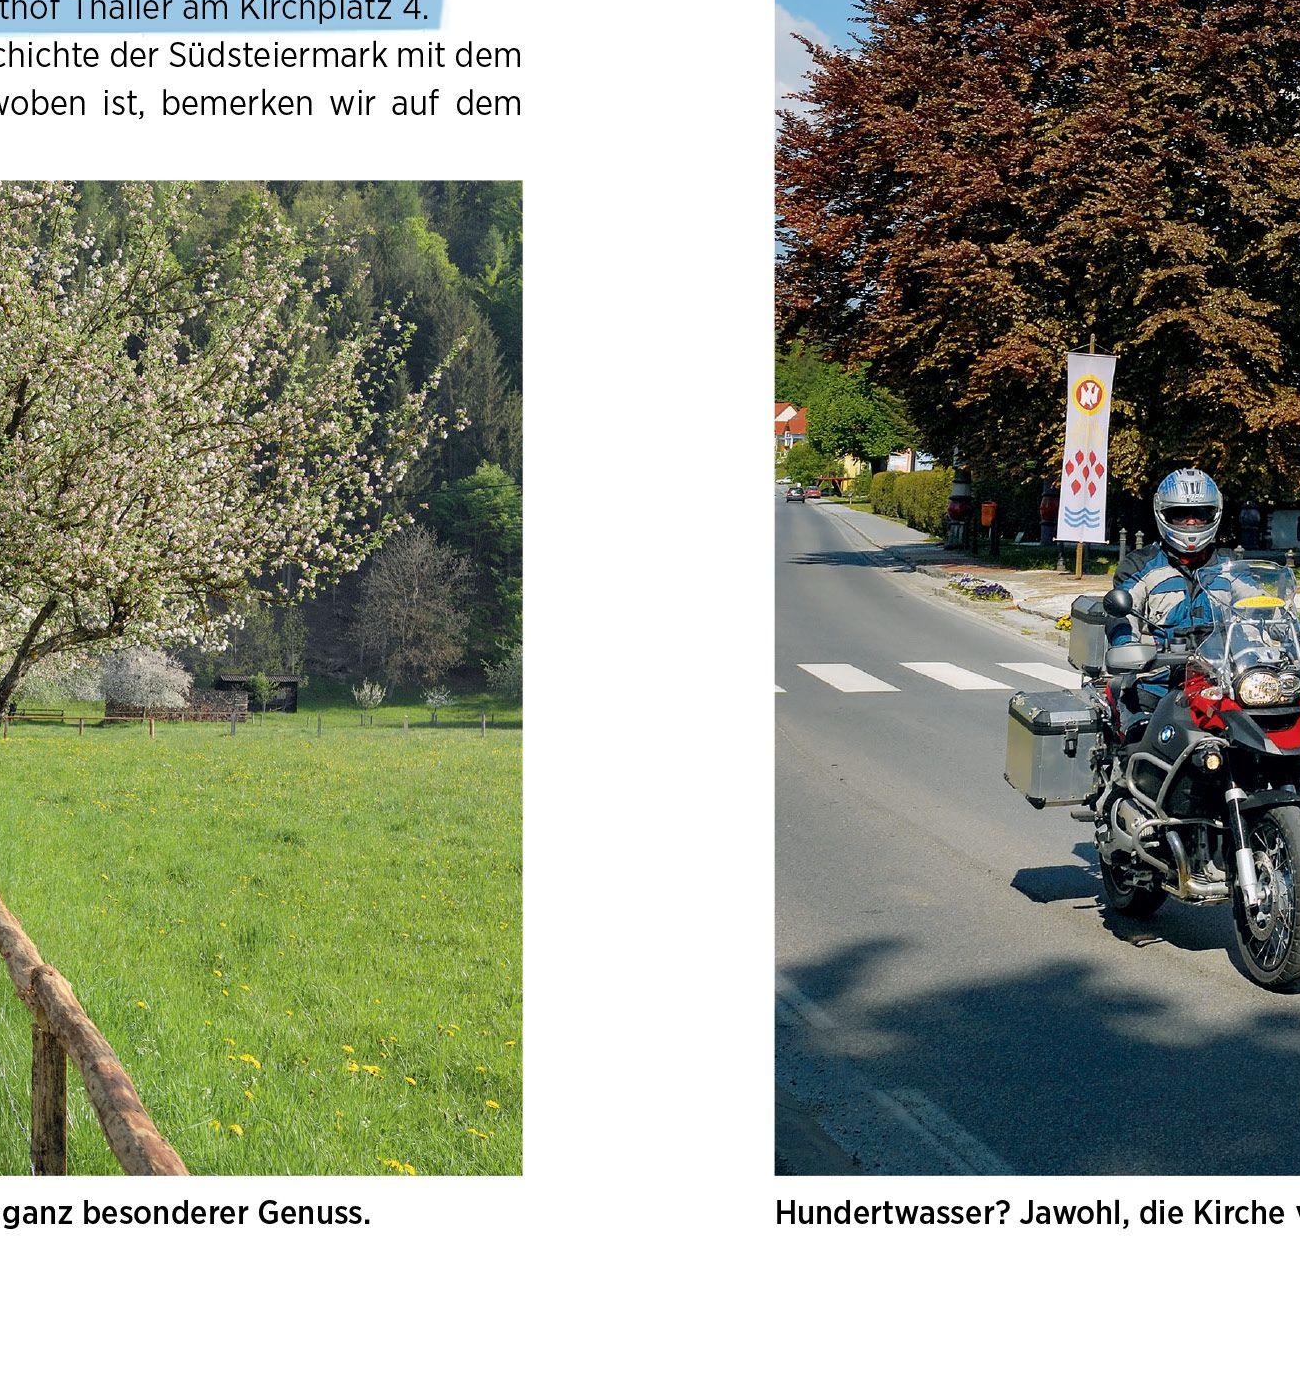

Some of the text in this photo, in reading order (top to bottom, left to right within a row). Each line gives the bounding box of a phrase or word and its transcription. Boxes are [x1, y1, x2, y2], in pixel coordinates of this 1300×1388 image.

[182, 0, 228, 20] am
[2, 1205, 73, 1230] ganz
[83, 1199, 249, 1225] besonderer
[258, 1199, 370, 1225] Genuss.
[776, 1199, 1011, 1225] Hundertwasser?
[1019, 1199, 1129, 1230] Jawohl,
[1139, 1199, 1184, 1225] die
[1194, 1199, 1285, 1225] Kirche
